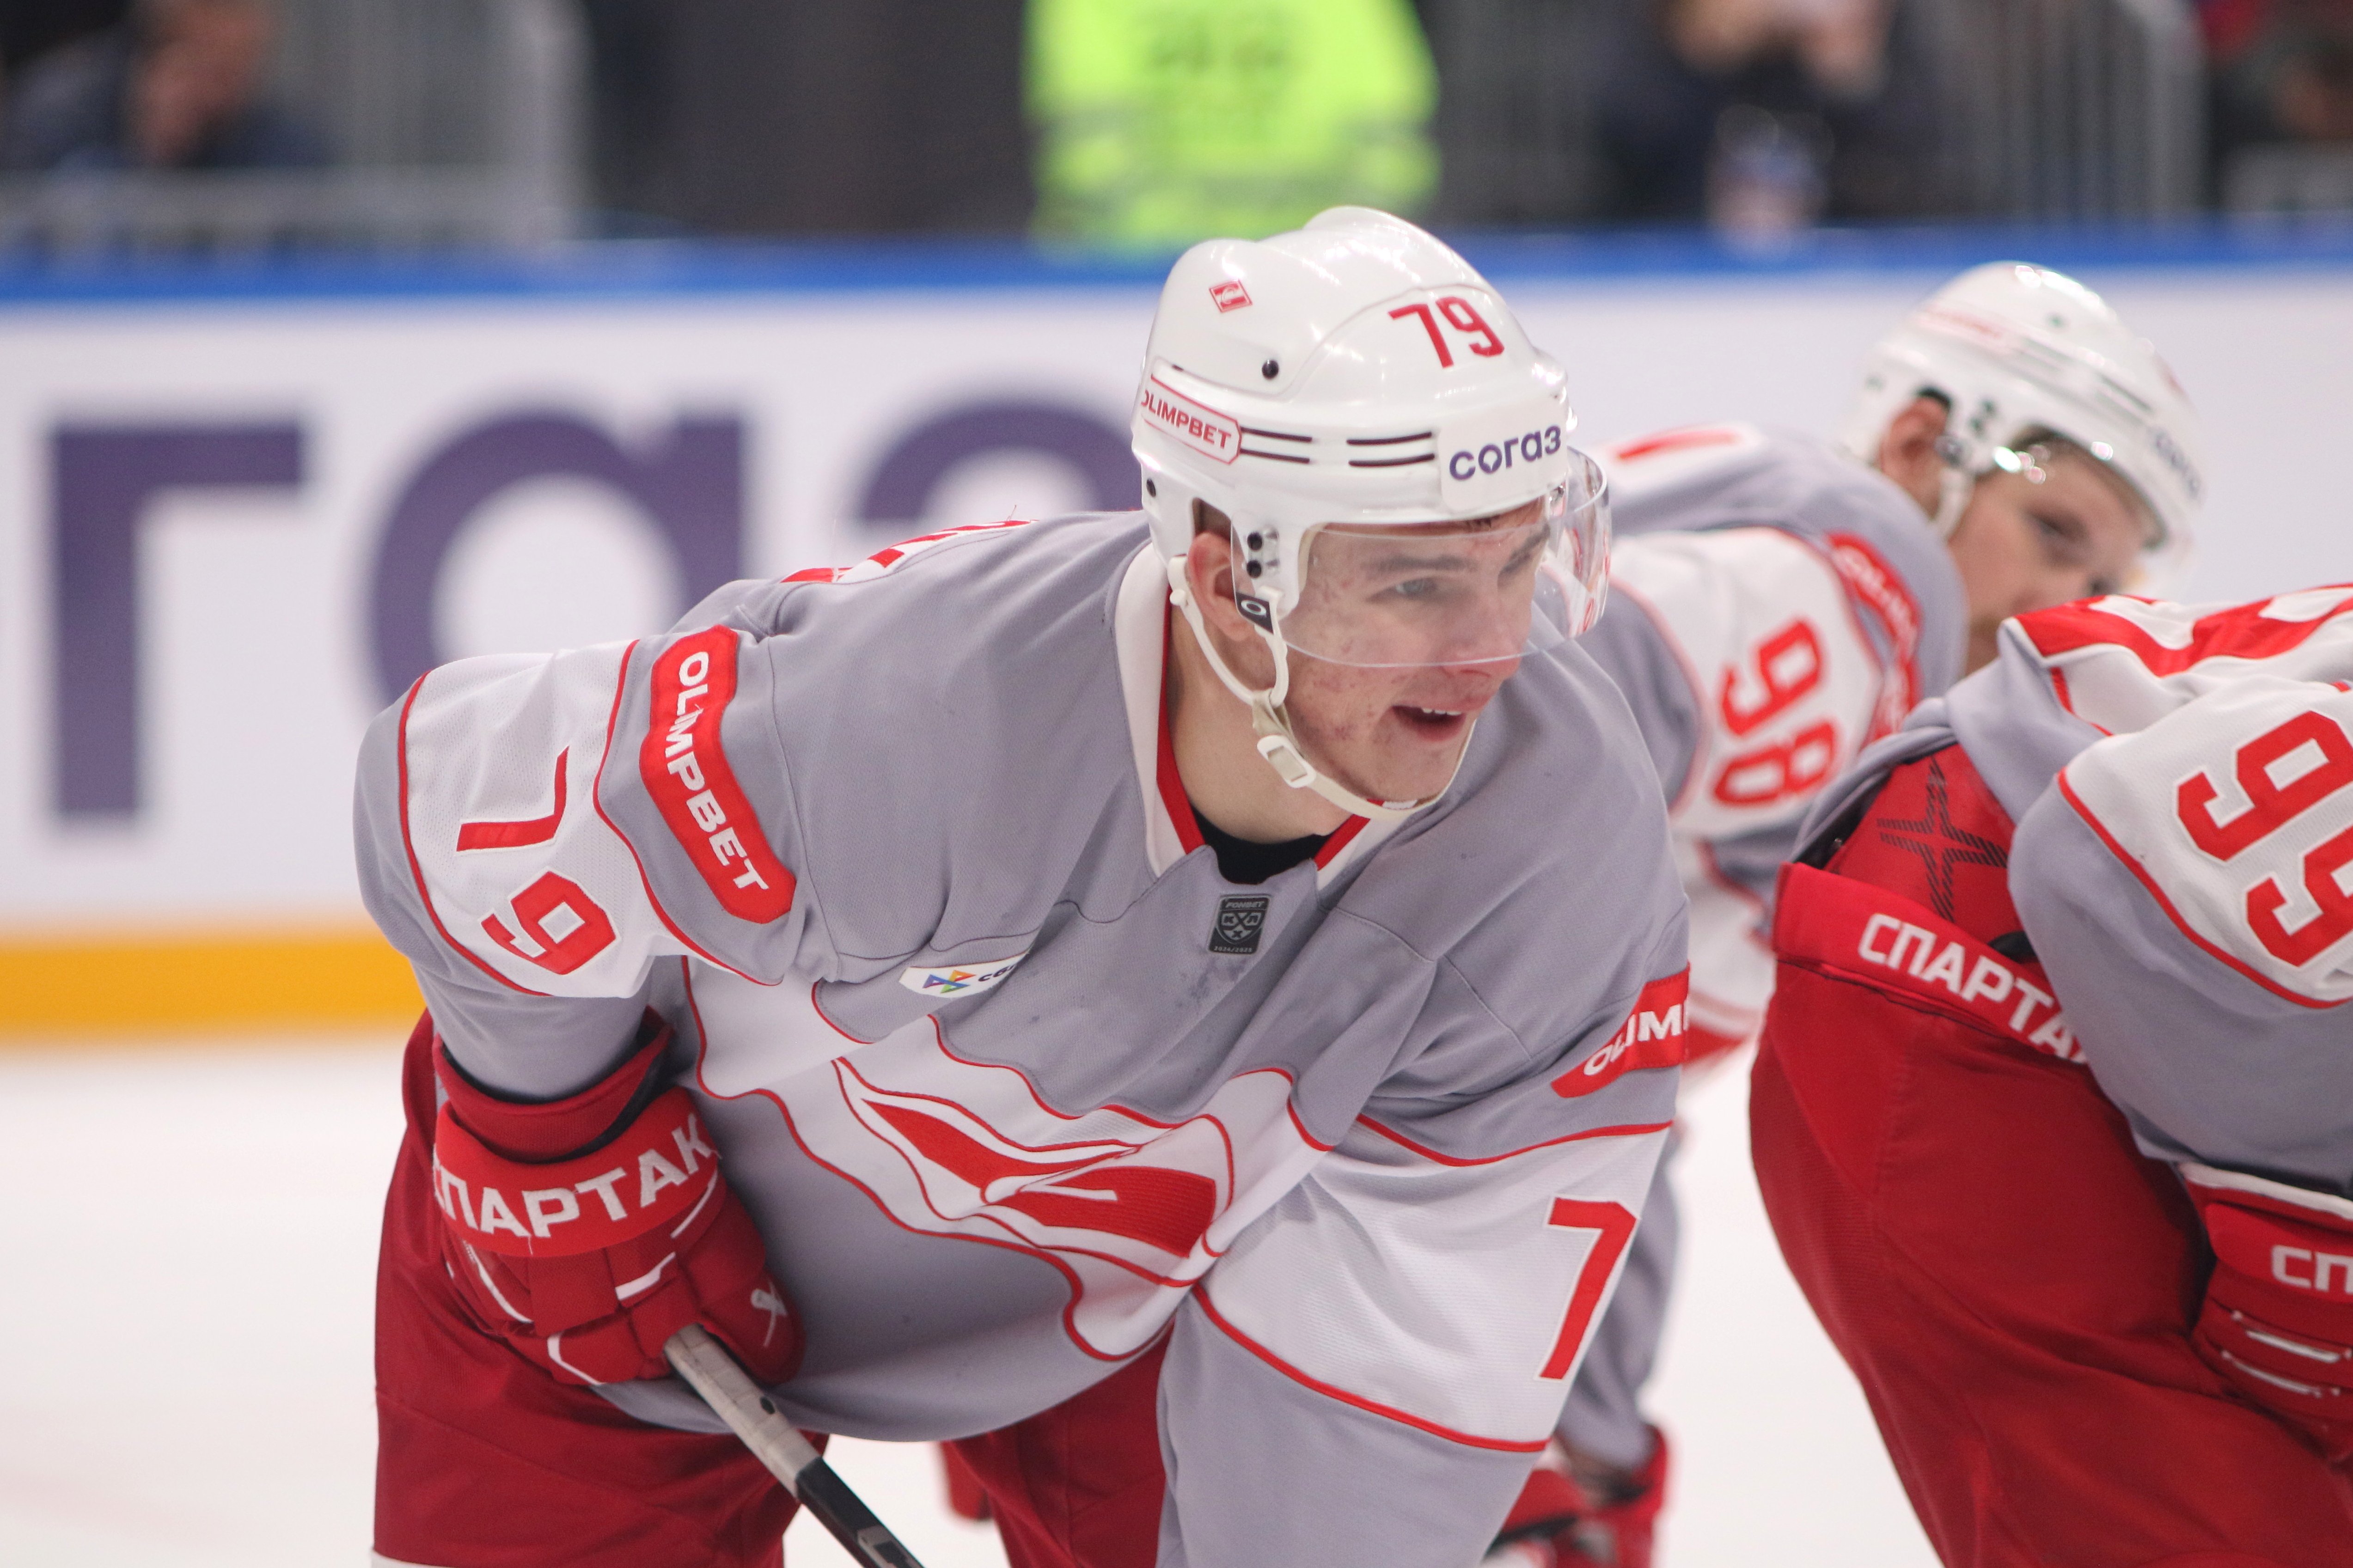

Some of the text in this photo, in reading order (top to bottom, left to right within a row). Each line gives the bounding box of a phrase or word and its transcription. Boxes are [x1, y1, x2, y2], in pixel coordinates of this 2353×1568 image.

[1387, 296, 1505, 369] 79
[1449, 424, 1561, 481] согаз
[664, 650, 769, 891] OLIMPBET
[1710, 617, 1837, 810] 98
[455, 744, 619, 977] 79
[1857, 912, 2089, 1064] СПАРТА
